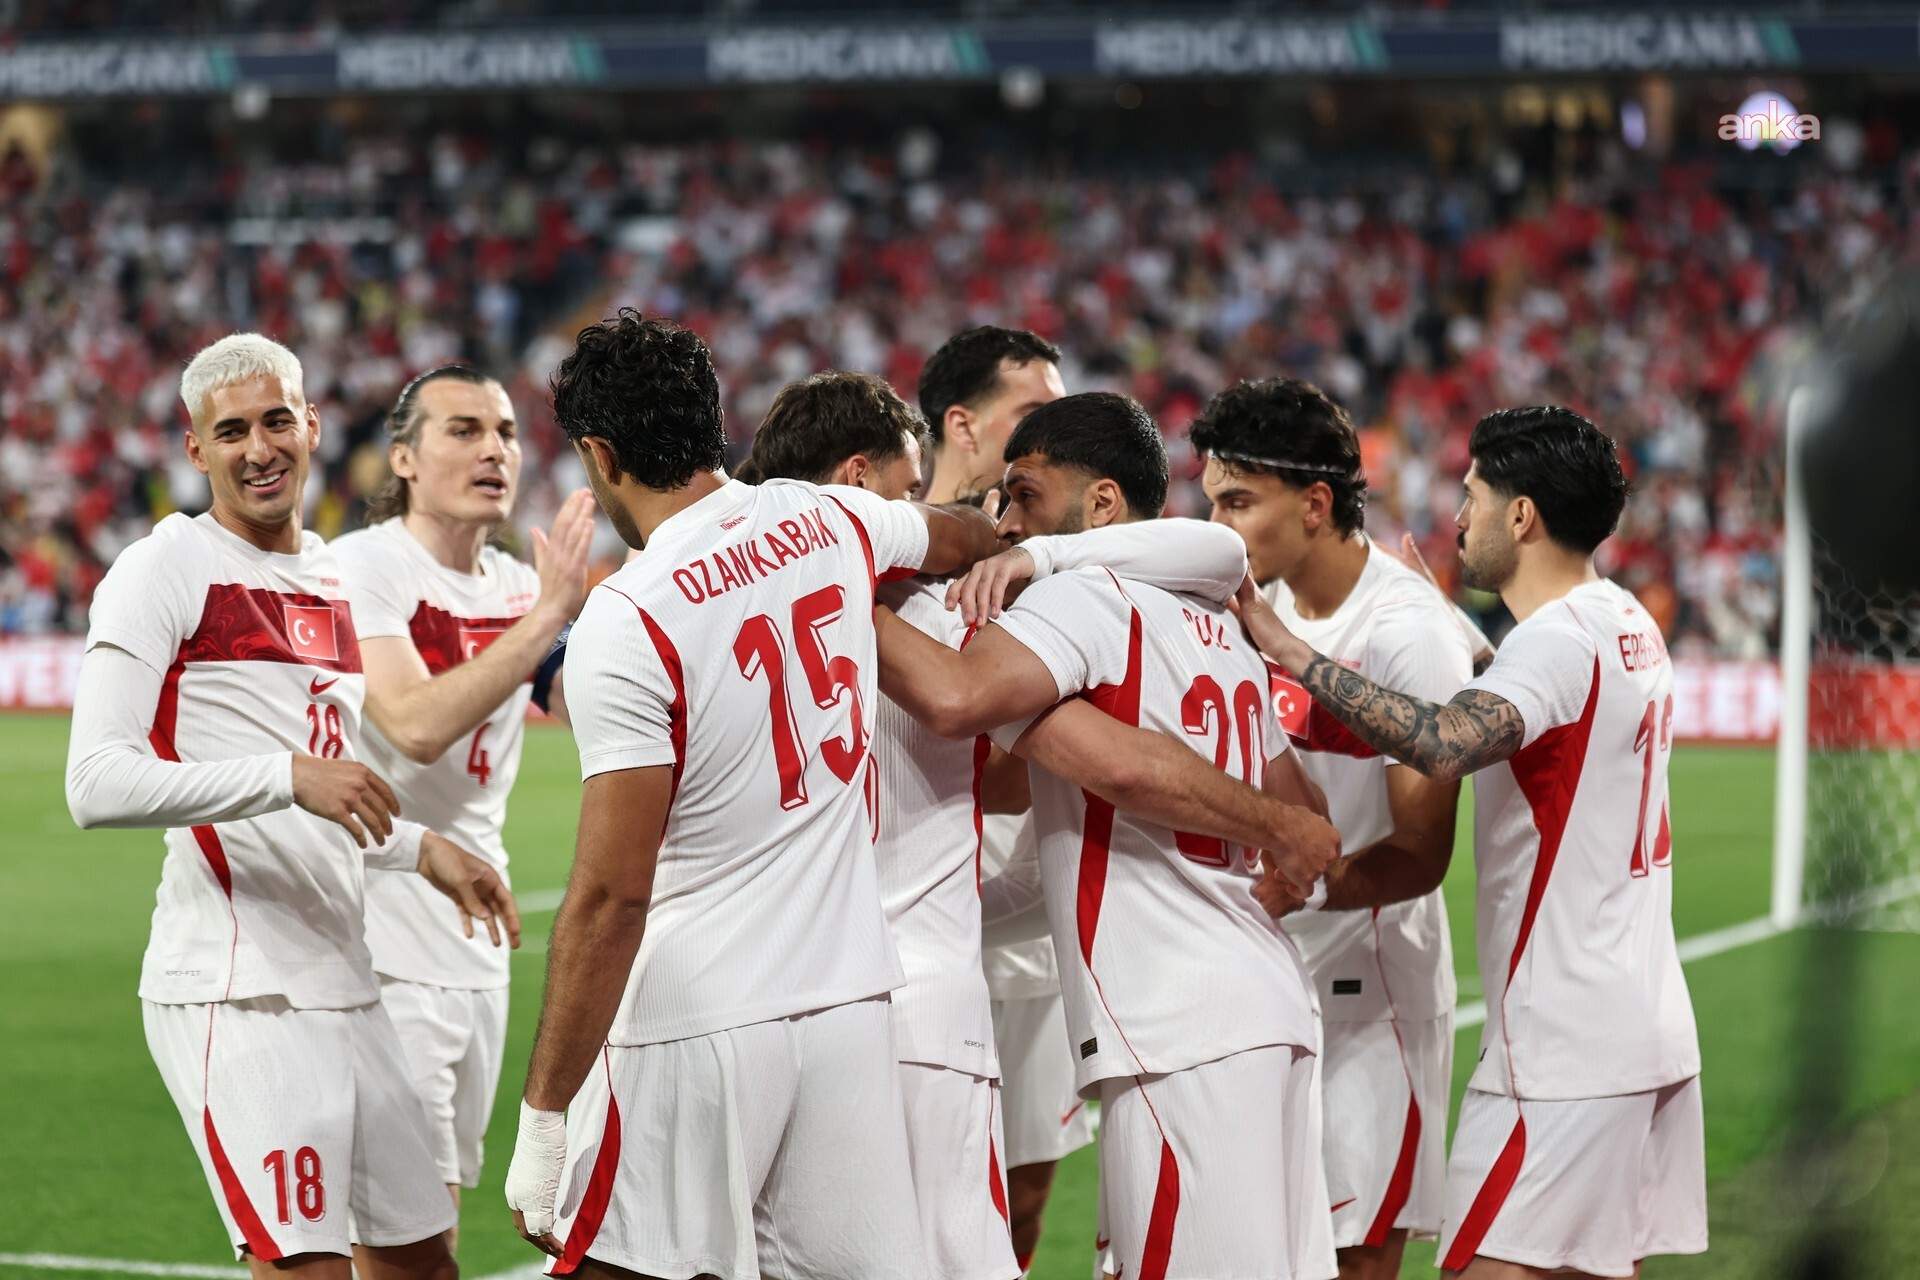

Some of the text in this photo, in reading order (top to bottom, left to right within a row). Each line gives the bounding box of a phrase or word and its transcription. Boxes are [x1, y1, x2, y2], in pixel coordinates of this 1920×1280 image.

[306, 703, 344, 759] 18
[733, 583, 870, 811] 15
[467, 722, 492, 788] 4
[1174, 675, 1265, 868] 20
[263, 1146, 326, 1225] 18
